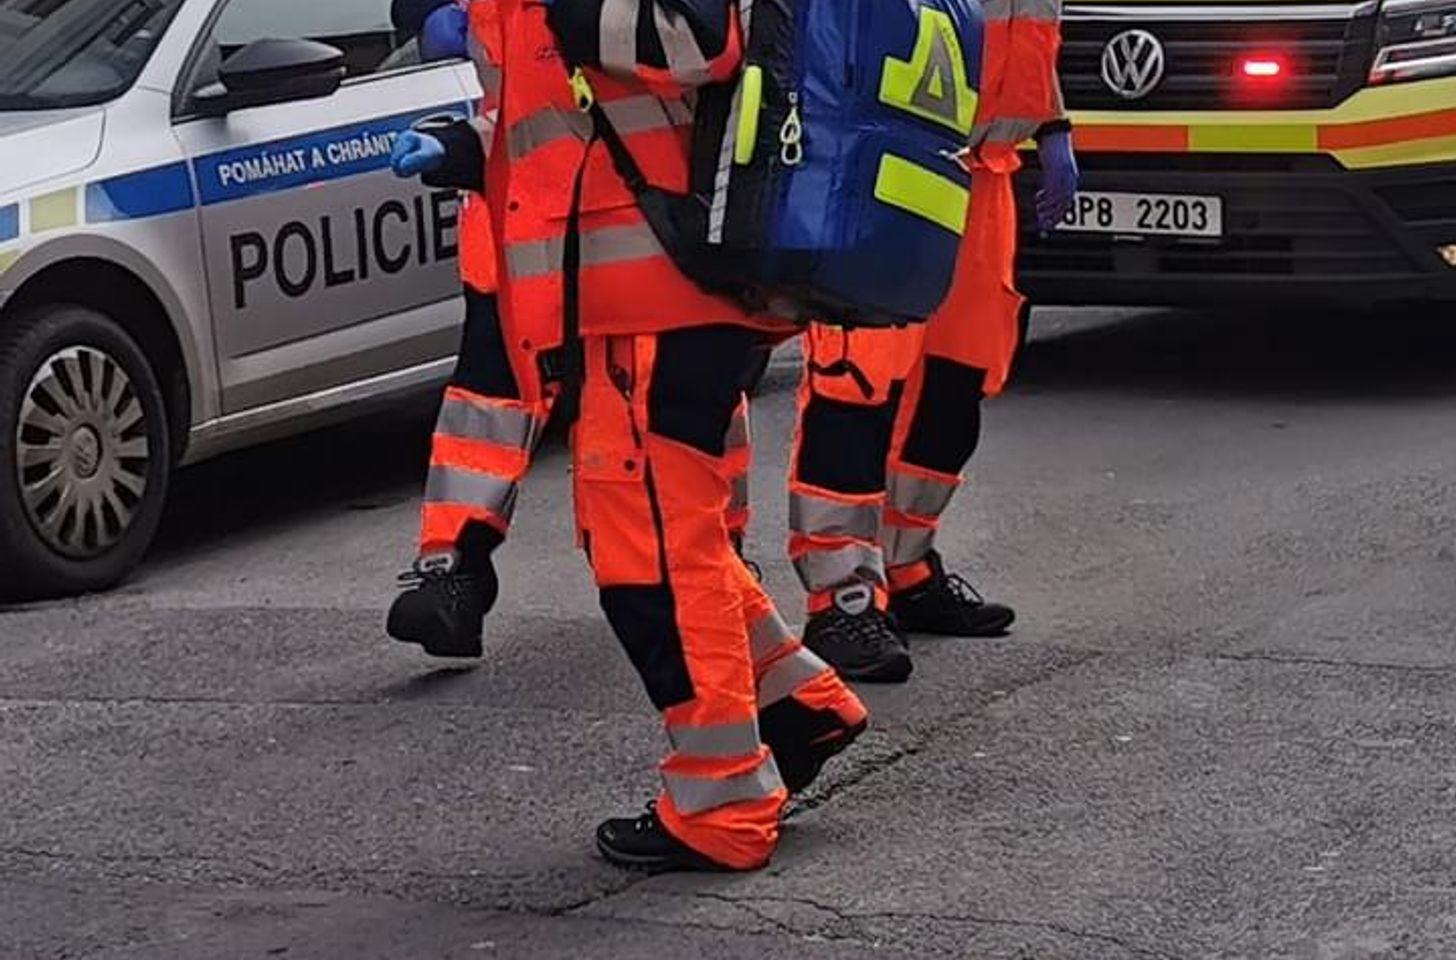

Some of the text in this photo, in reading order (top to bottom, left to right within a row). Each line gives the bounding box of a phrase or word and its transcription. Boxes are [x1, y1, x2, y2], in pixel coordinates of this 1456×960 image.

[218, 149, 305, 186] POMÁHAT
[312, 150, 326, 169] A
[1136, 199, 1208, 230] 2203
[230, 189, 459, 309] POLICIE
